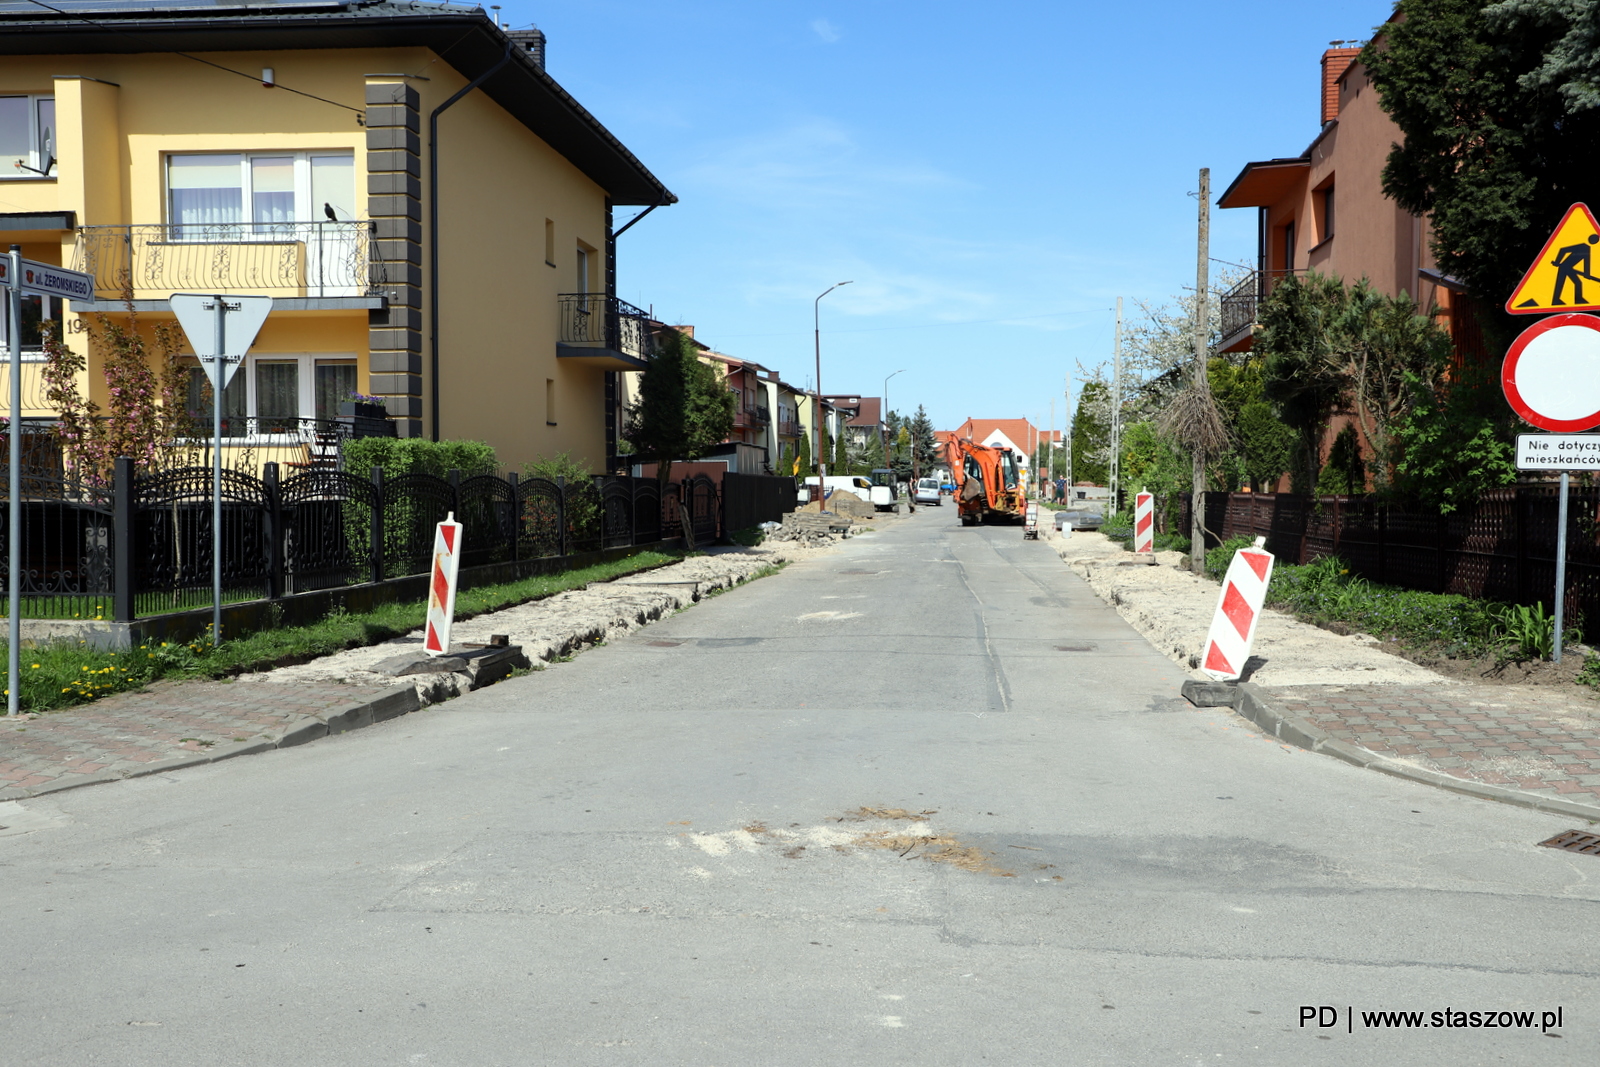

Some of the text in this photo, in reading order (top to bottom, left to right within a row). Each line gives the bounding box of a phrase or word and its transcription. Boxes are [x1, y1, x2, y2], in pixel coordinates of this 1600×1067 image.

[35, 271, 87, 295] ul. ŻEROMSKIEGO
[1528, 440, 1549, 450] Nie
